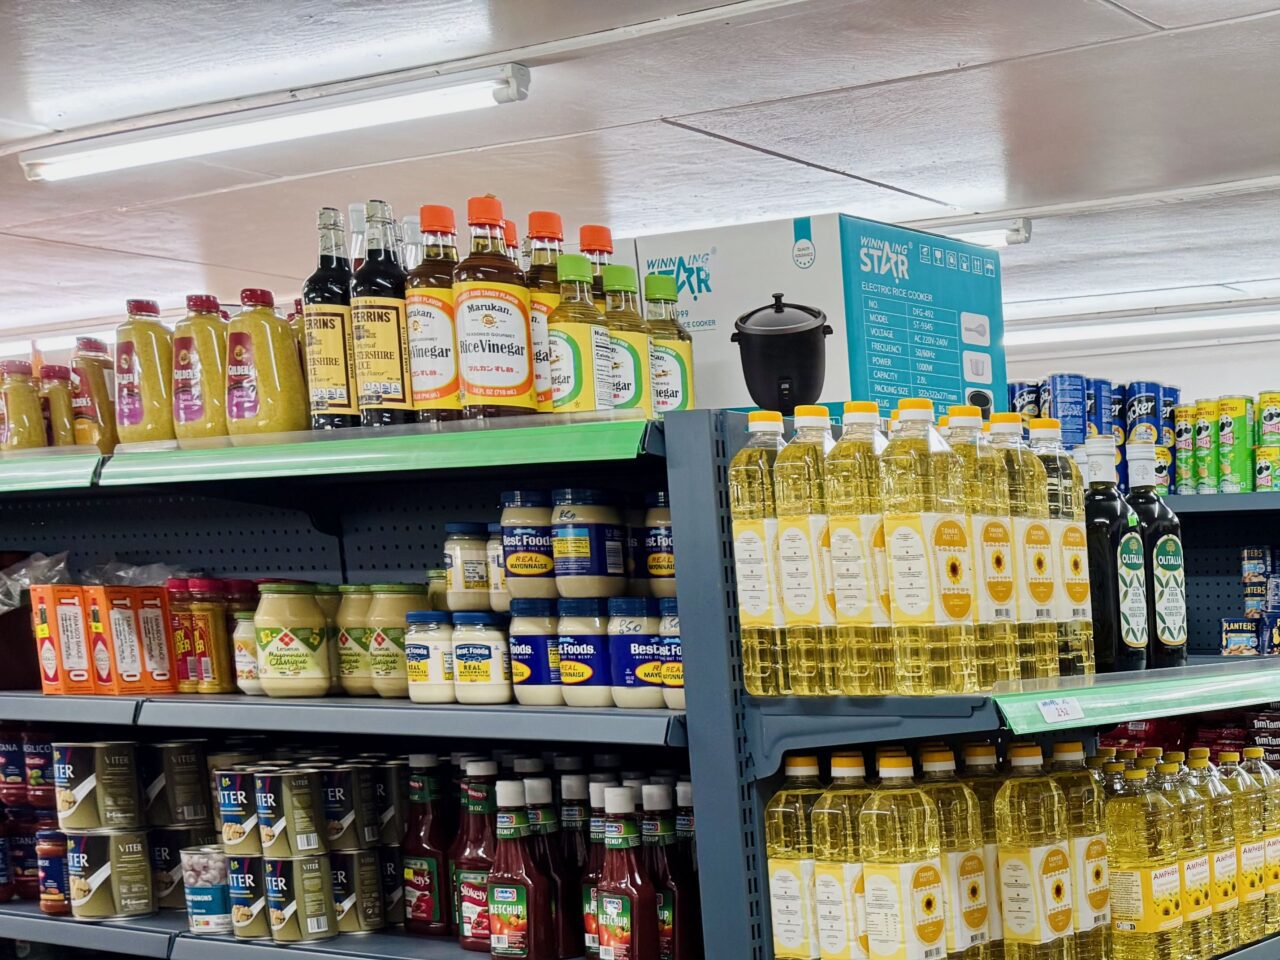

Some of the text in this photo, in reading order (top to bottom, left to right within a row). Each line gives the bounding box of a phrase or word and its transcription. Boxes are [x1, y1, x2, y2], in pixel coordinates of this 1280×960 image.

[646, 253, 709, 270] WINNING
[862, 282, 933, 302] ELECTRIC RICE COOKER
[353, 310, 391, 323] PERRINS
[869, 313, 889, 324] MODEL
[692, 319, 716, 327] COOKER
[870, 328, 894, 339] VOLTAGE
[871, 341, 902, 354] FREQUENCY
[309, 357, 340, 366] ERSHIRE
[872, 356, 892, 367] POWER
[873, 370, 898, 381] CAPACITY
[874, 384, 909, 396] PACKING SIZE
[1158, 554, 1183, 566] OLITALIA
[1223, 622, 1256, 631] PLANTERS
[54, 763, 75, 779] TER
[67, 852, 89, 868] TER
[490, 904, 523, 915] KETCHUP
